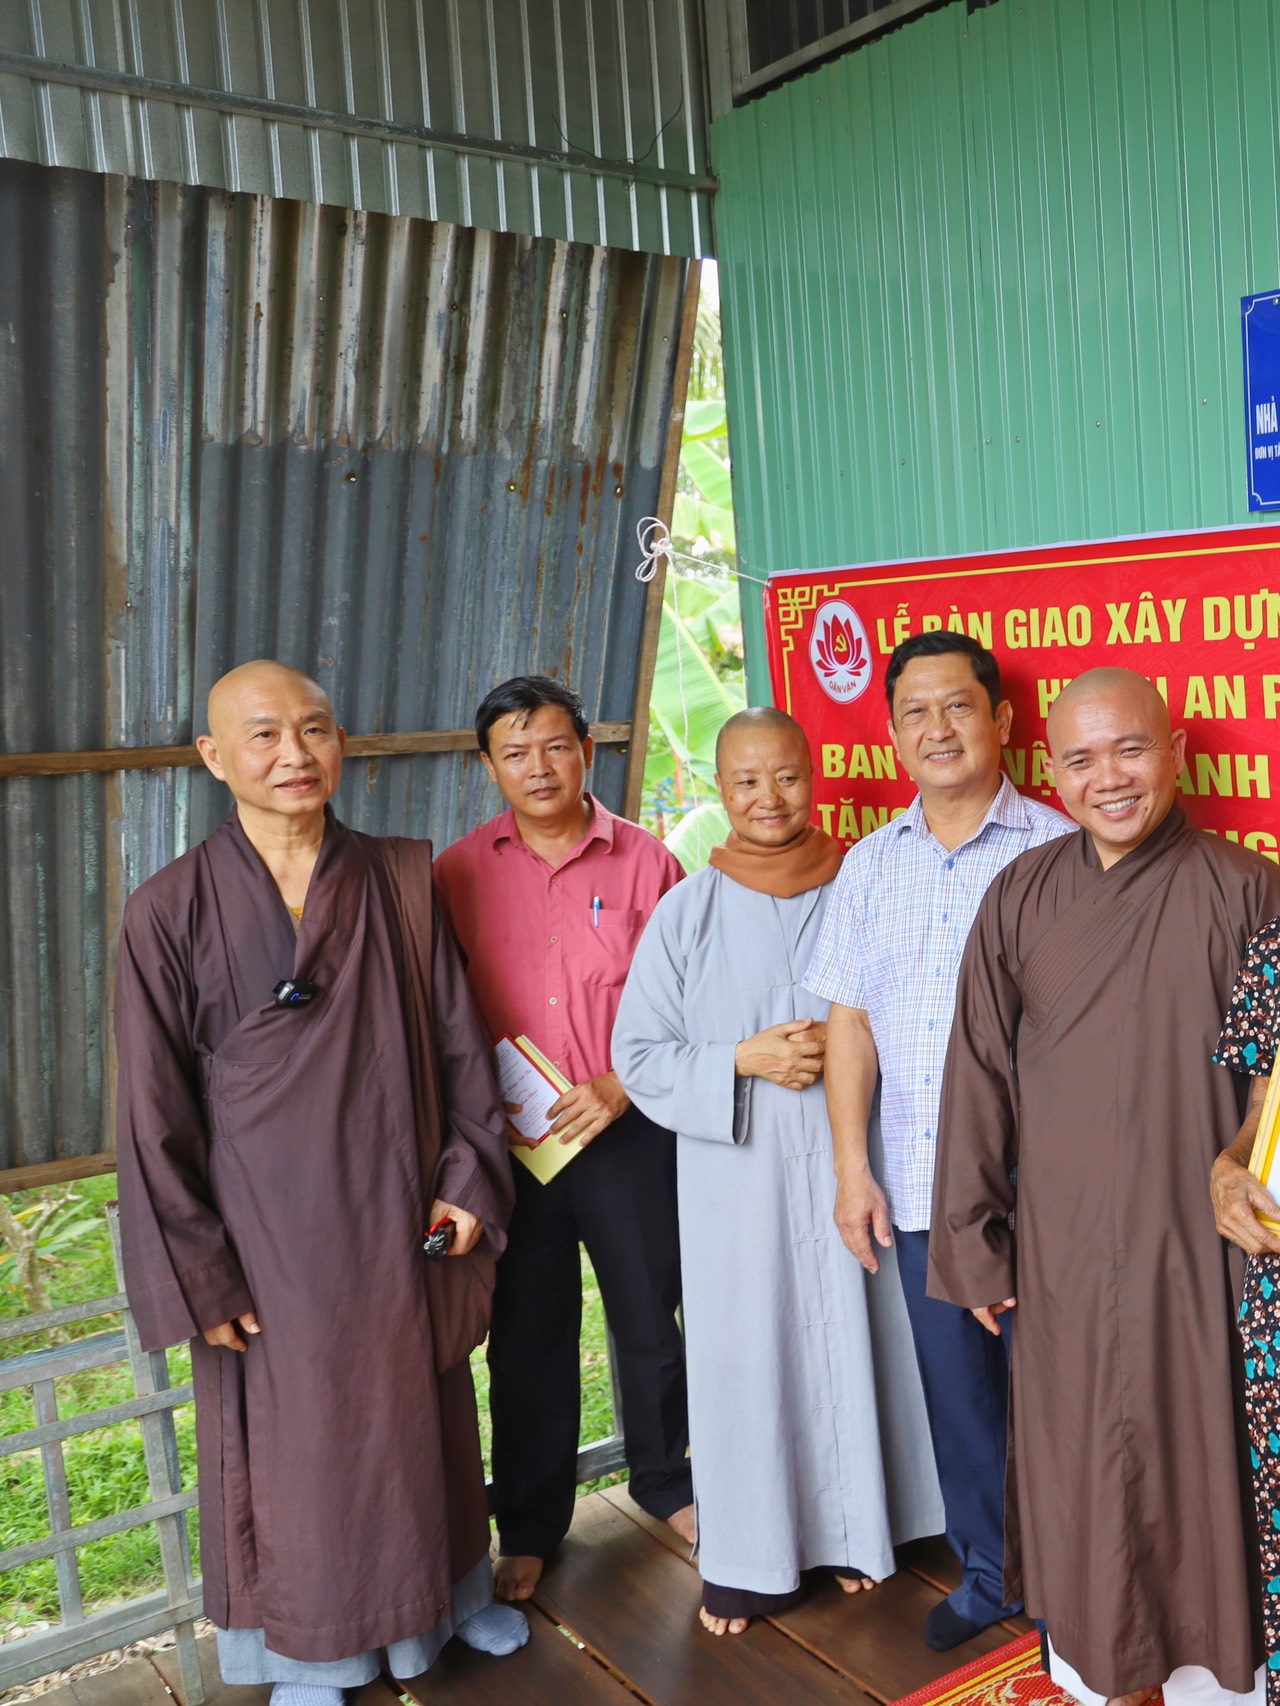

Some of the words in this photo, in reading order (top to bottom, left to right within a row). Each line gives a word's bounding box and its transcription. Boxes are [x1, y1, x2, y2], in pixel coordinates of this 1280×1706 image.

[1255, 395, 1278, 435] NHÀ
[1267, 445, 1274, 460] VỊ
[877, 602, 910, 654] LỄ
[1005, 606, 1092, 649] GIAO
[1106, 592, 1187, 644] XÂY
[1184, 675, 1247, 719] AN
[822, 744, 897, 780] BAN
[1002, 741, 1059, 796] VẬ
